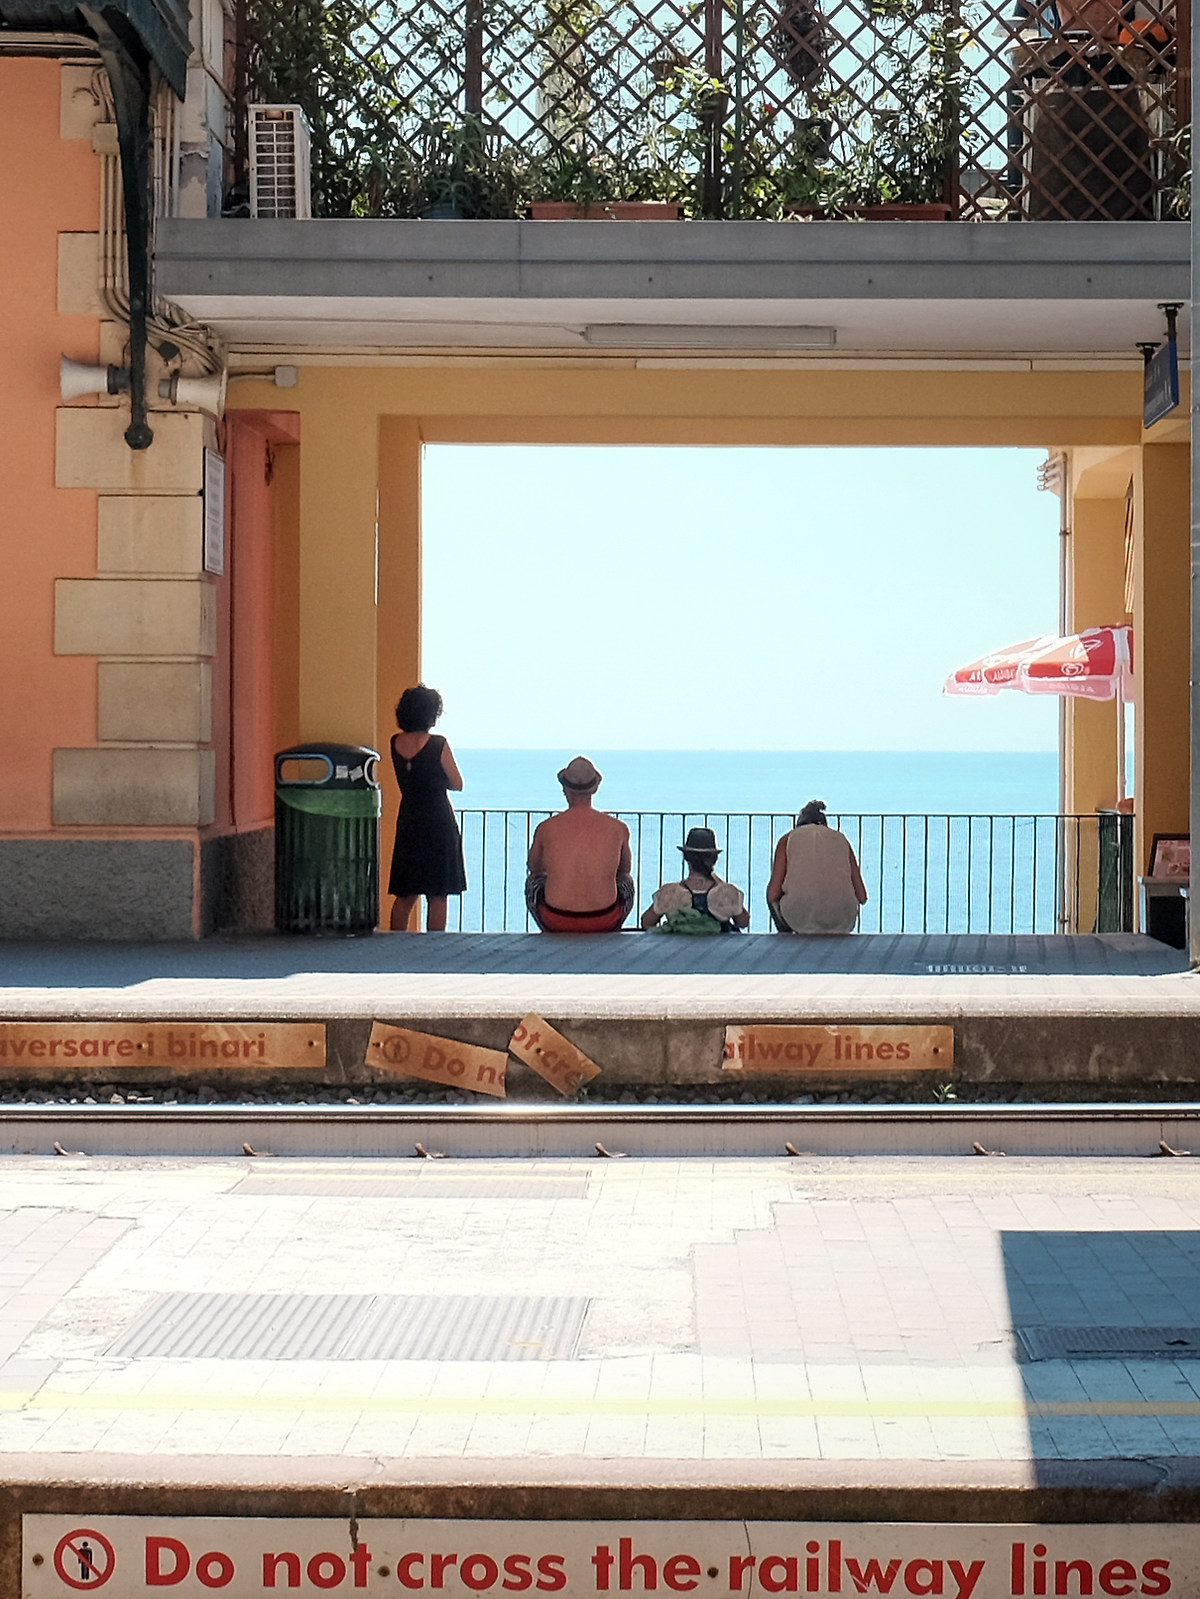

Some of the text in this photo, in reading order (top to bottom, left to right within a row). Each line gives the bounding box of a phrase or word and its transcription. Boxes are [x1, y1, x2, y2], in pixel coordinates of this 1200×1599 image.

[147, 1032, 155, 1057] i
[167, 1032, 266, 1058] binari
[834, 1034, 911, 1061] lines
[422, 1046, 466, 1076] Do
[145, 1536, 1171, 1599] Do not cross the railway lines
